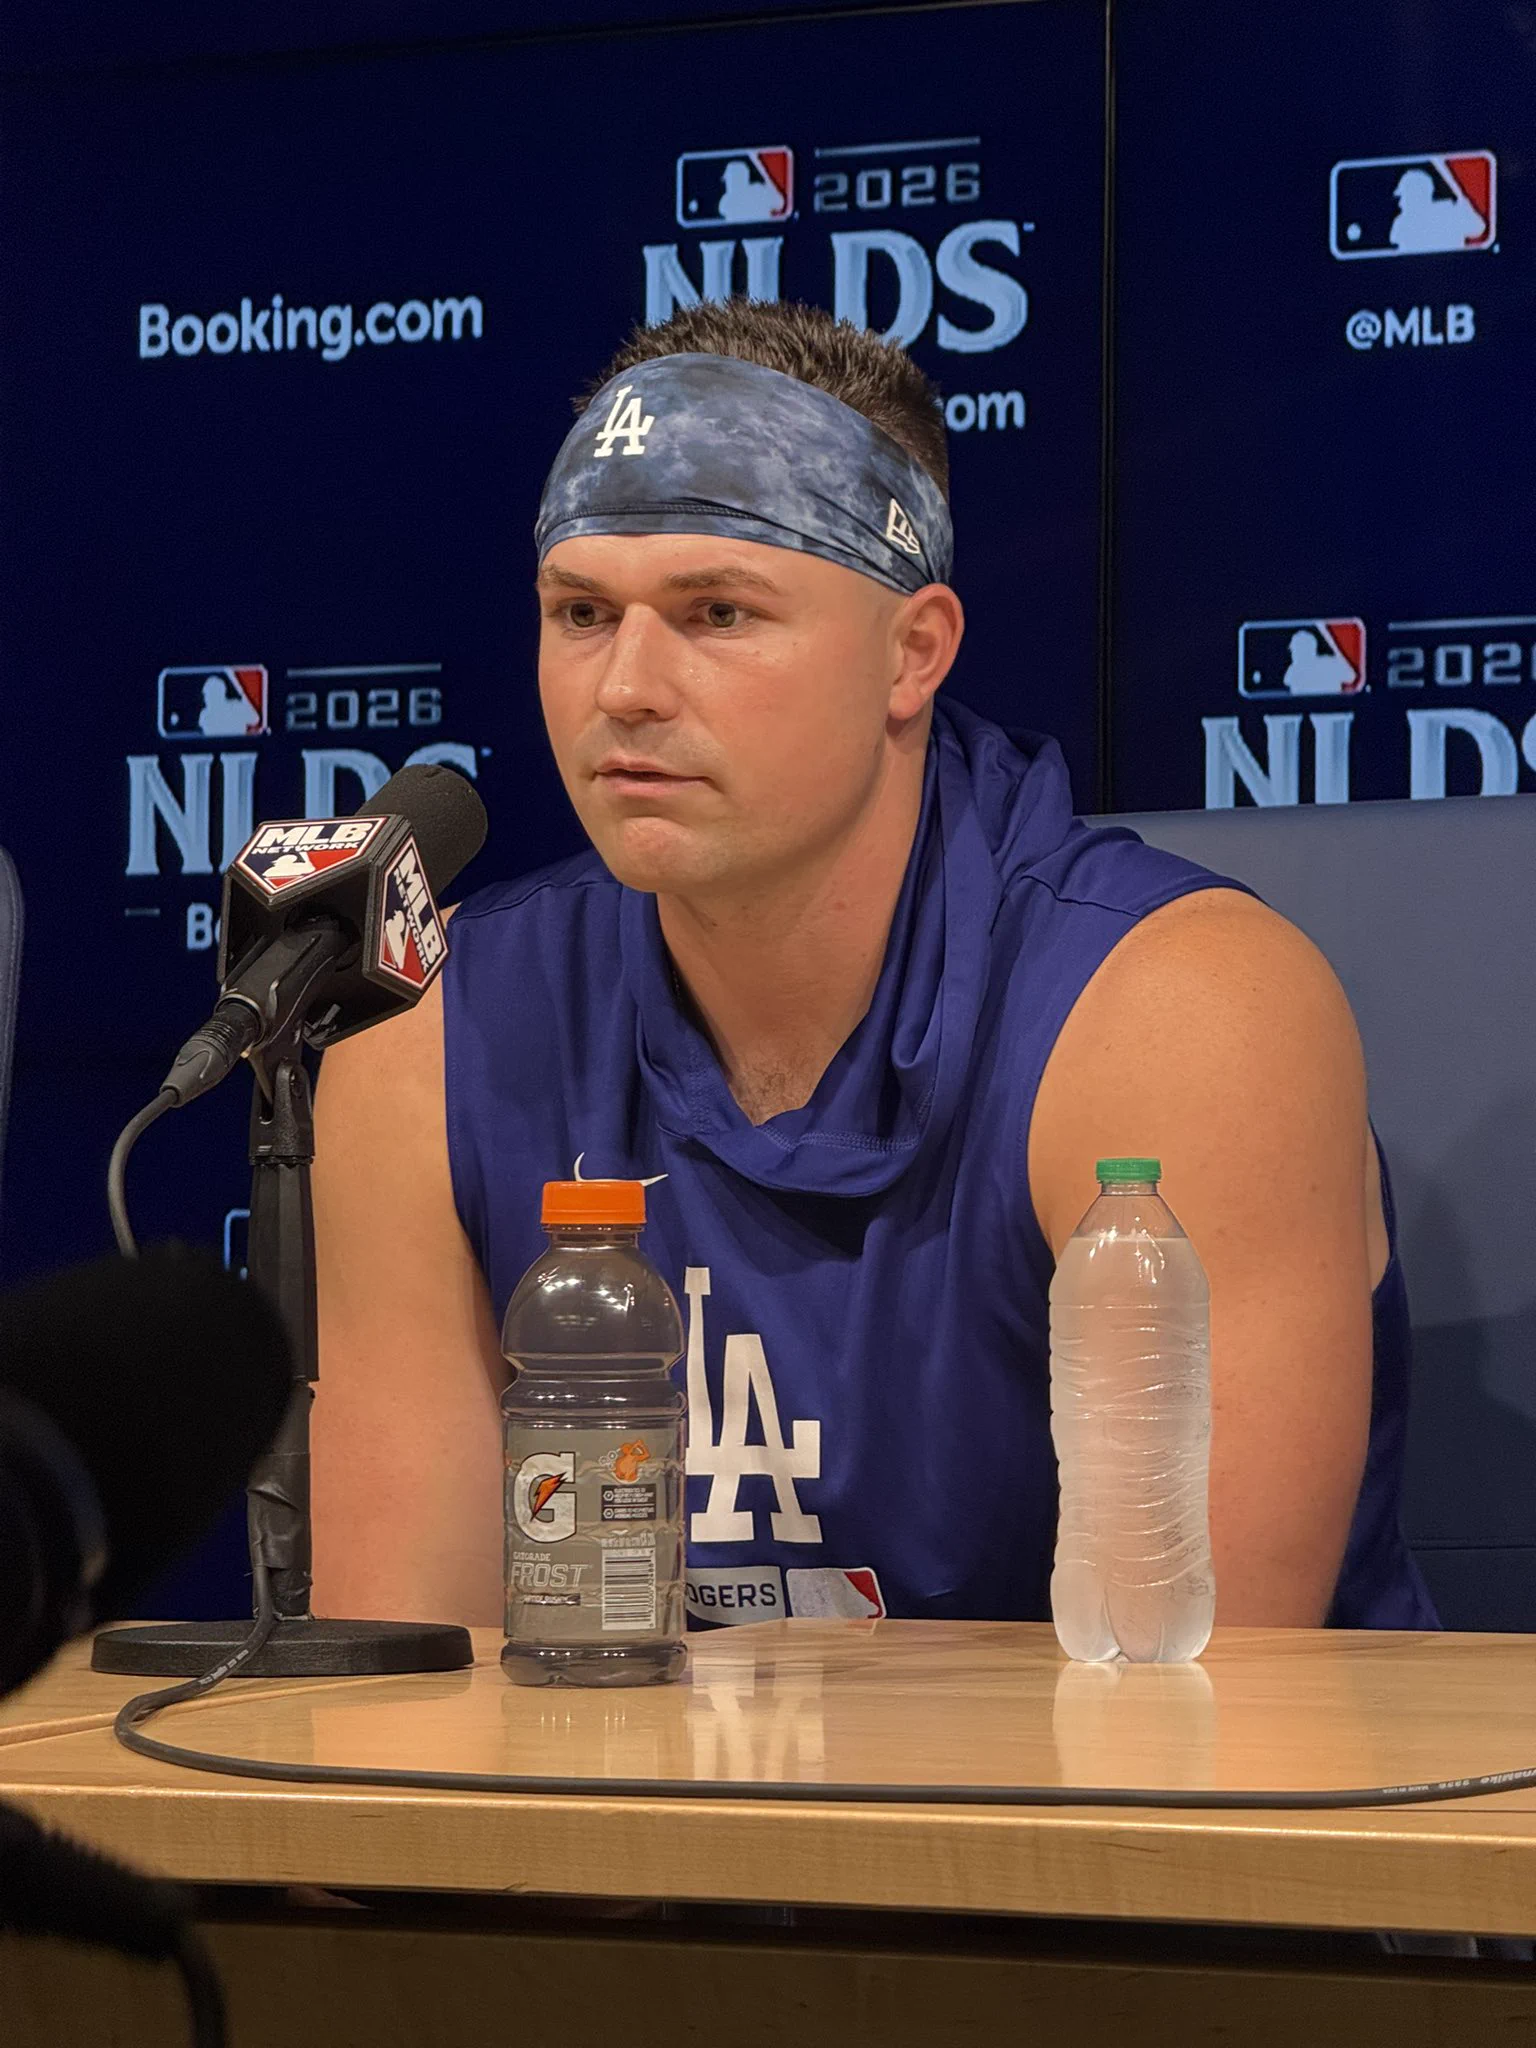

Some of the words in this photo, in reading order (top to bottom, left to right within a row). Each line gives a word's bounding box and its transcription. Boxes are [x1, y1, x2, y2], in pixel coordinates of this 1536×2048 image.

[814, 163, 981, 213] 2026
[139, 293, 484, 361] Booking.com
[1345, 303, 1476, 350] @MLB
[593, 385, 655, 458] LA
[286, 688, 443, 730] 2026
[251, 842, 360, 855] NETWORK
[256, 822, 373, 848] MLB
[393, 867, 429, 974] NETWORK
[399, 847, 442, 964] MLB
[684, 1266, 823, 1544] LA
[514, 1451, 577, 1543] G
[510, 1561, 589, 1588] FROST
[686, 1583, 777, 1608] DGERS
